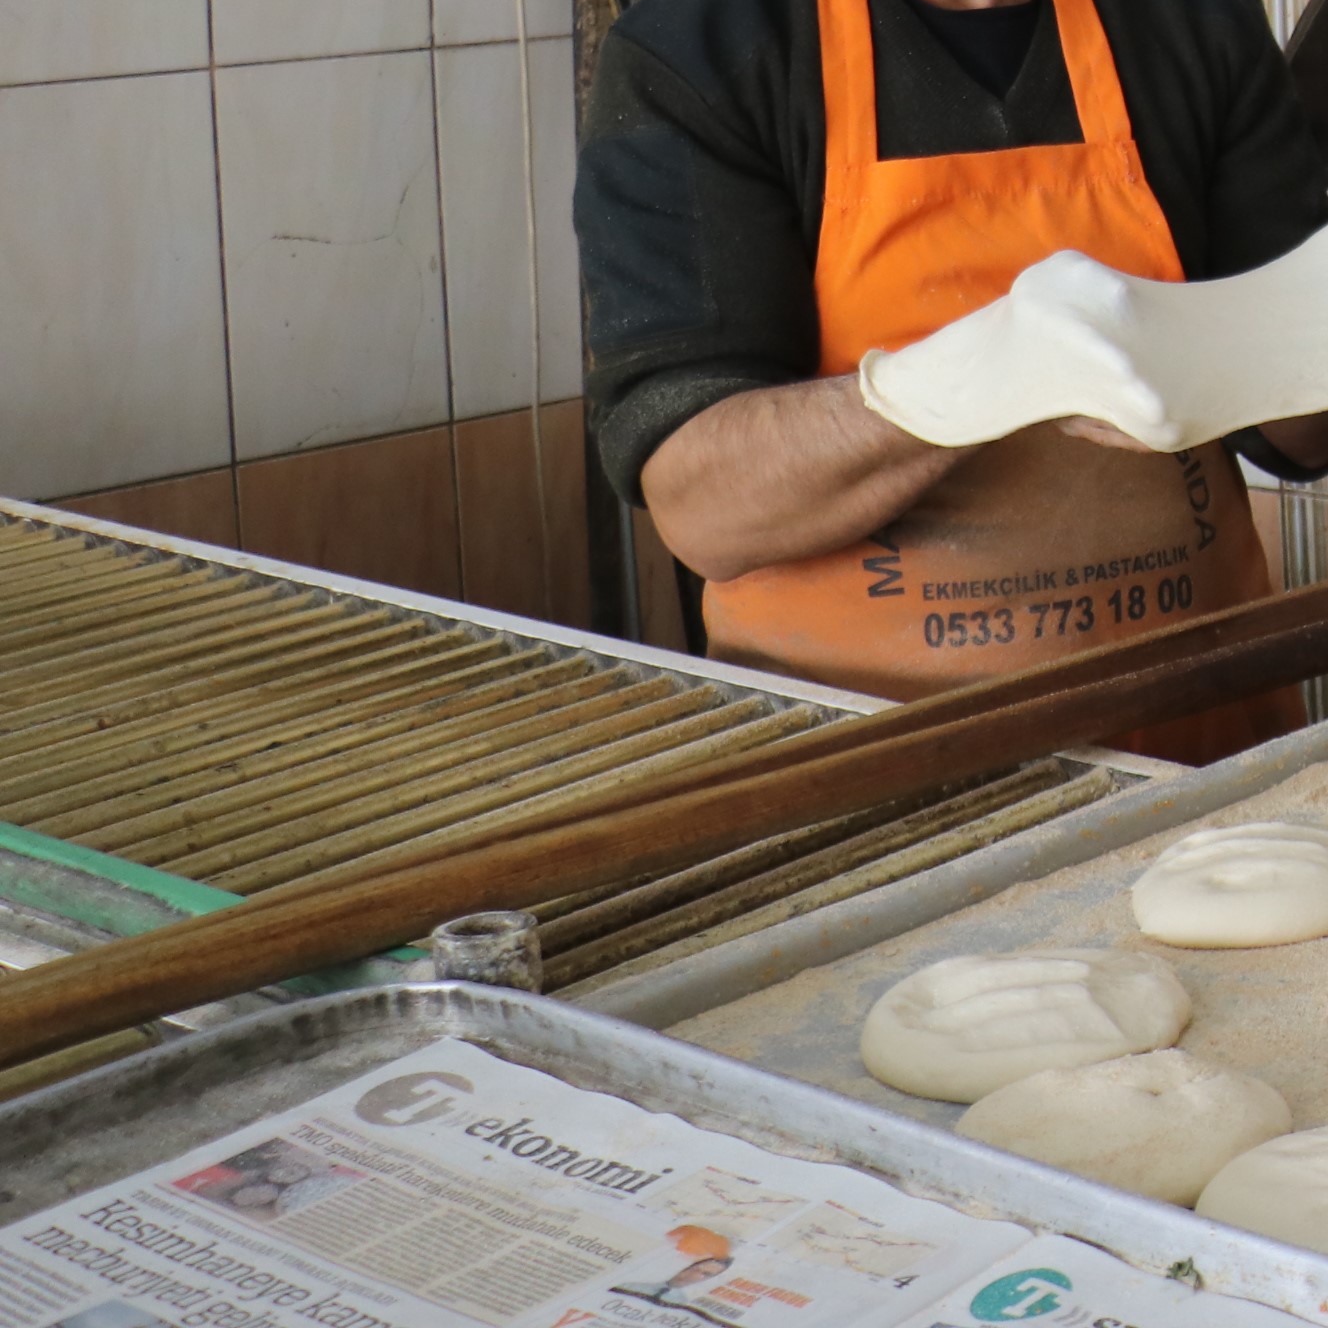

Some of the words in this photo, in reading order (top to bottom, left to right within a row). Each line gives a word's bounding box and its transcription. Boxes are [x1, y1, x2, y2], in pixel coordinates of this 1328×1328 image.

[922, 570, 1057, 601] EKMEKÇİLİK
[1065, 568, 1080, 586] &
[1083, 545, 1190, 583] PASTACILIK
[924, 607, 1016, 648] 0533
[1029, 596, 1095, 639] 773
[1107, 584, 1146, 623] 18
[1158, 574, 1193, 614] 00
[464, 1118, 673, 1194] ekonomi
[22, 1226, 224, 1308] mecburiyeti
[80, 1198, 311, 1307] Kesimhaneye
[567, 1234, 632, 1264] edecek
